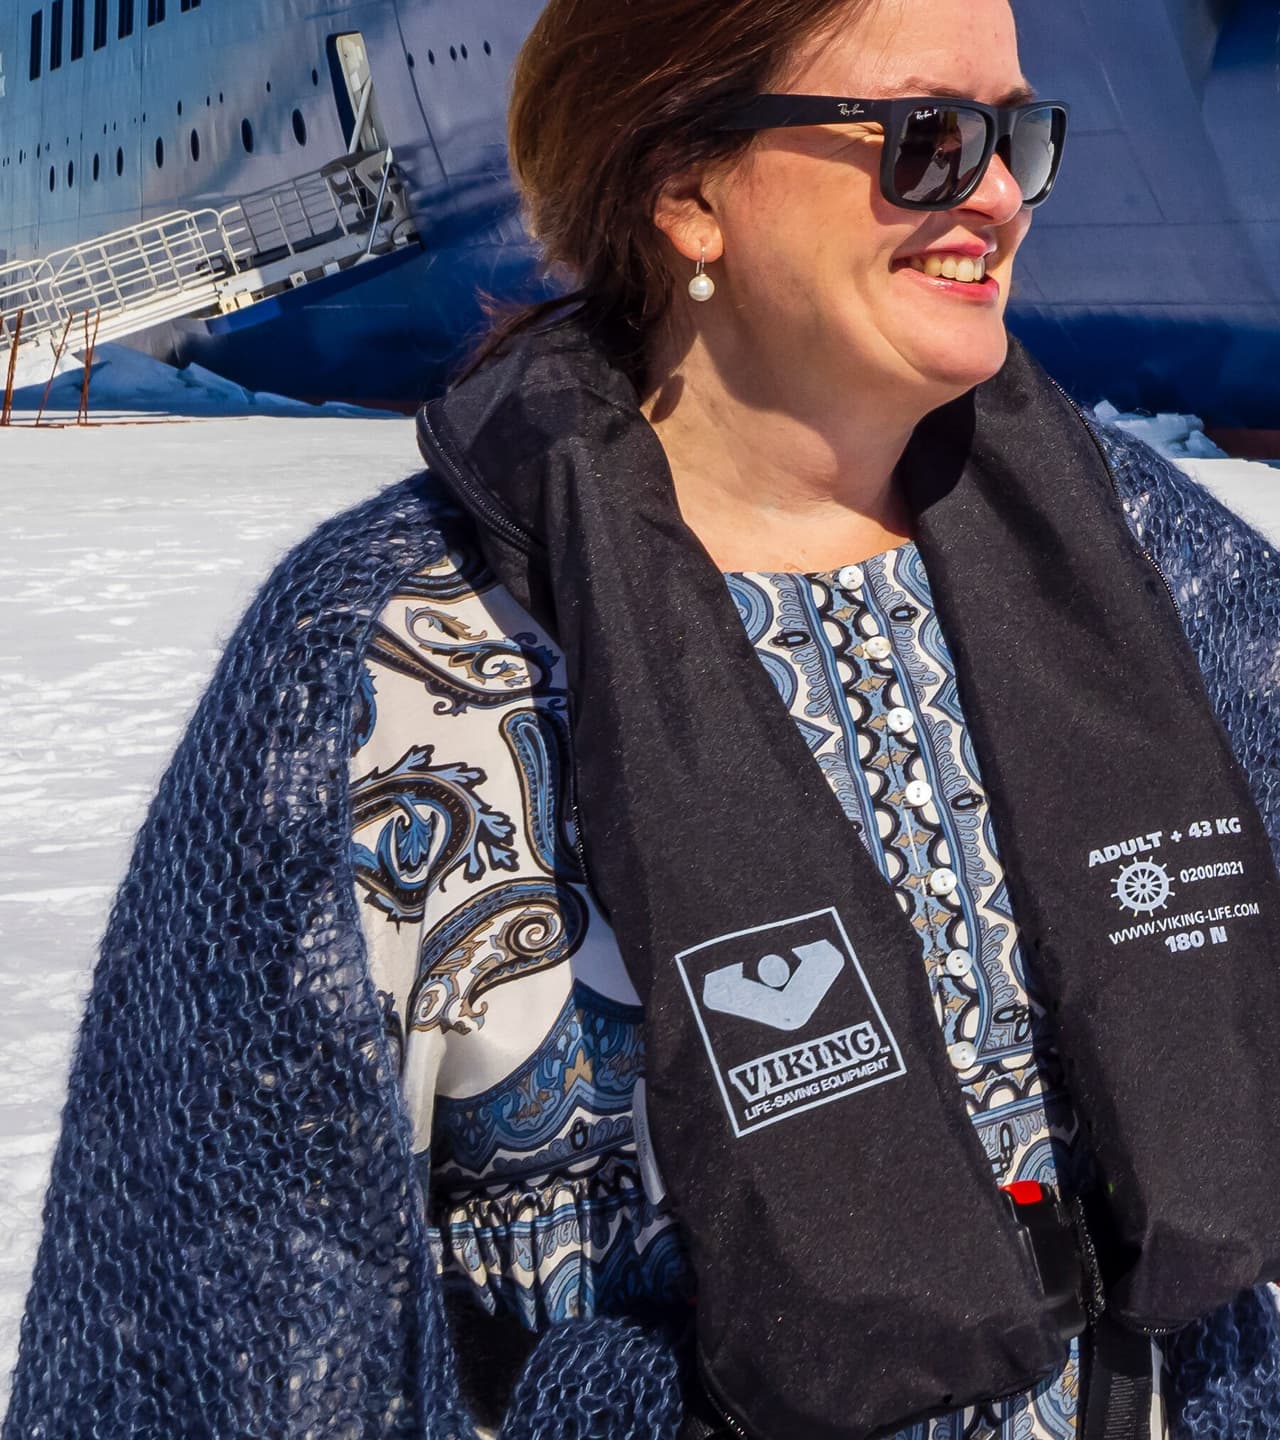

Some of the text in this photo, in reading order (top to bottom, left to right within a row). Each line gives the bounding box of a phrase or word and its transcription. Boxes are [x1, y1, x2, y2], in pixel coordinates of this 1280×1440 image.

[1088, 831, 1163, 868] ADULT
[1188, 821, 1212, 838] 43
[1216, 817, 1241, 834] KG
[1180, 861, 1244, 883] 0200/2021
[1109, 903, 1260, 945] WWW.VIKING-LIFE.COM
[1165, 926, 1228, 953] 180 N
[732, 1025, 878, 1098] VIKING
[744, 1056, 889, 1120] LIFE-SAVING EQUIPMENT
